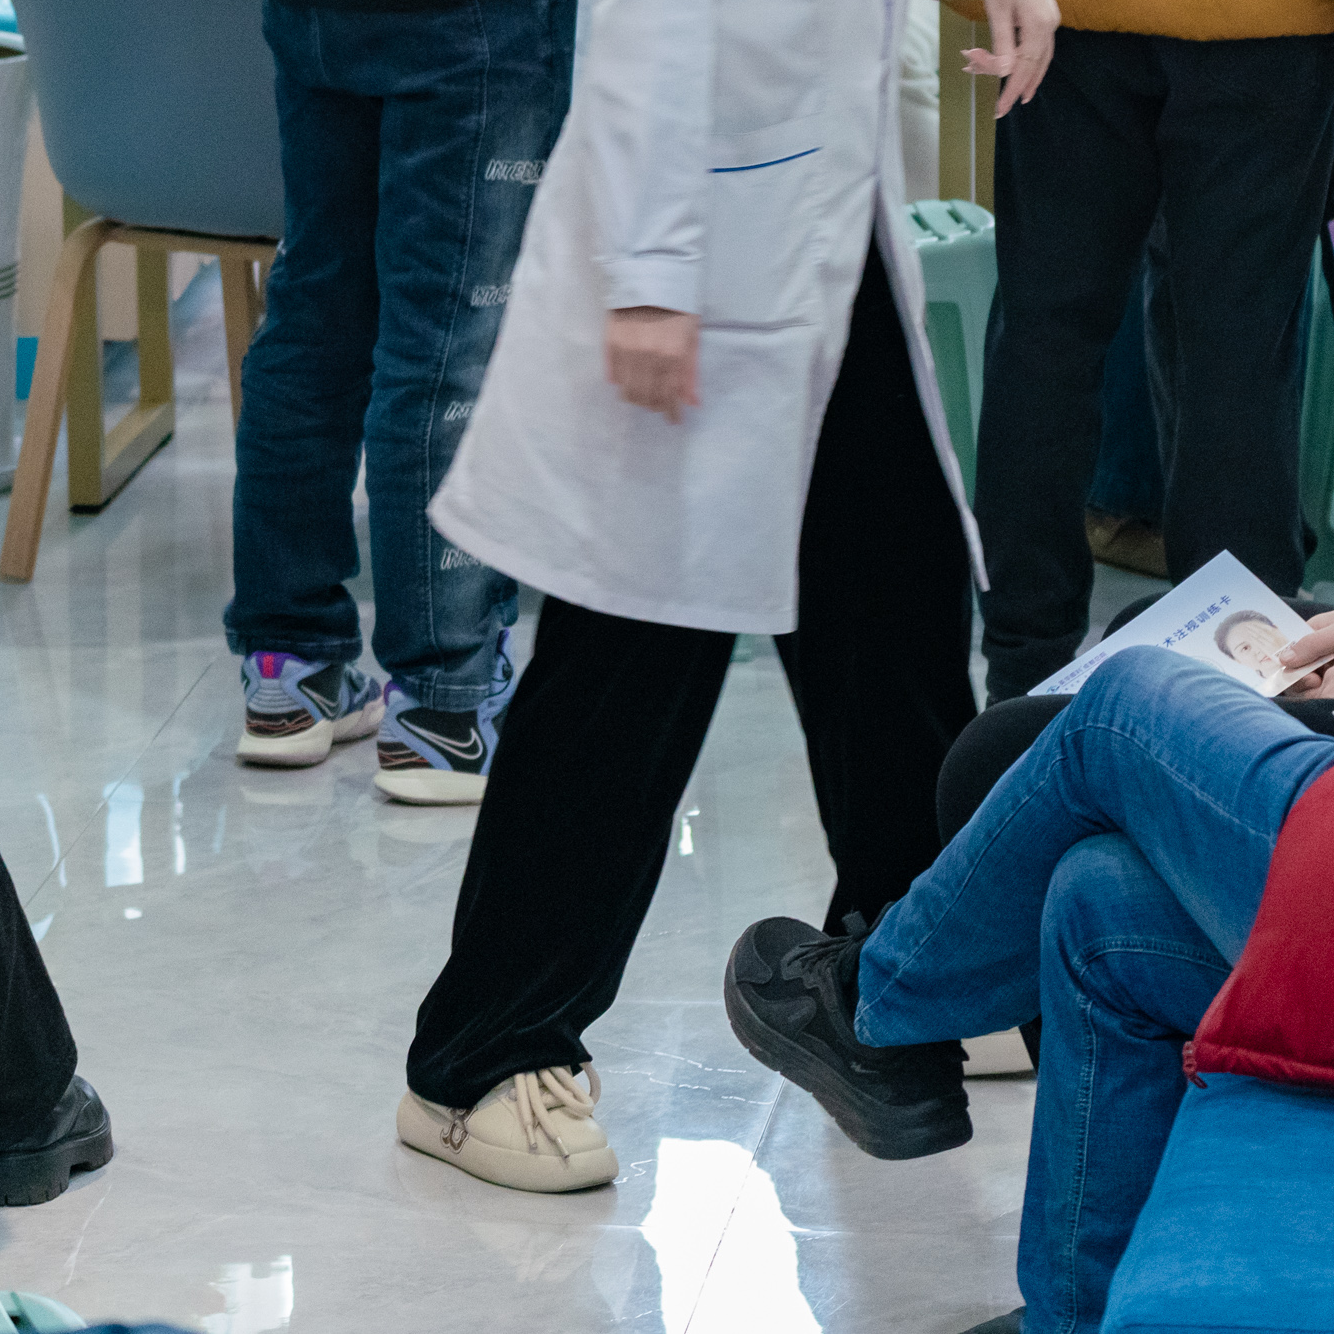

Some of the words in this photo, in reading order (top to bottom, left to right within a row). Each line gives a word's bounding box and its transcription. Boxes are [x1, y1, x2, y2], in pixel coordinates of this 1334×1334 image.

[1156, 594, 1232, 648] 术注视训练卡
